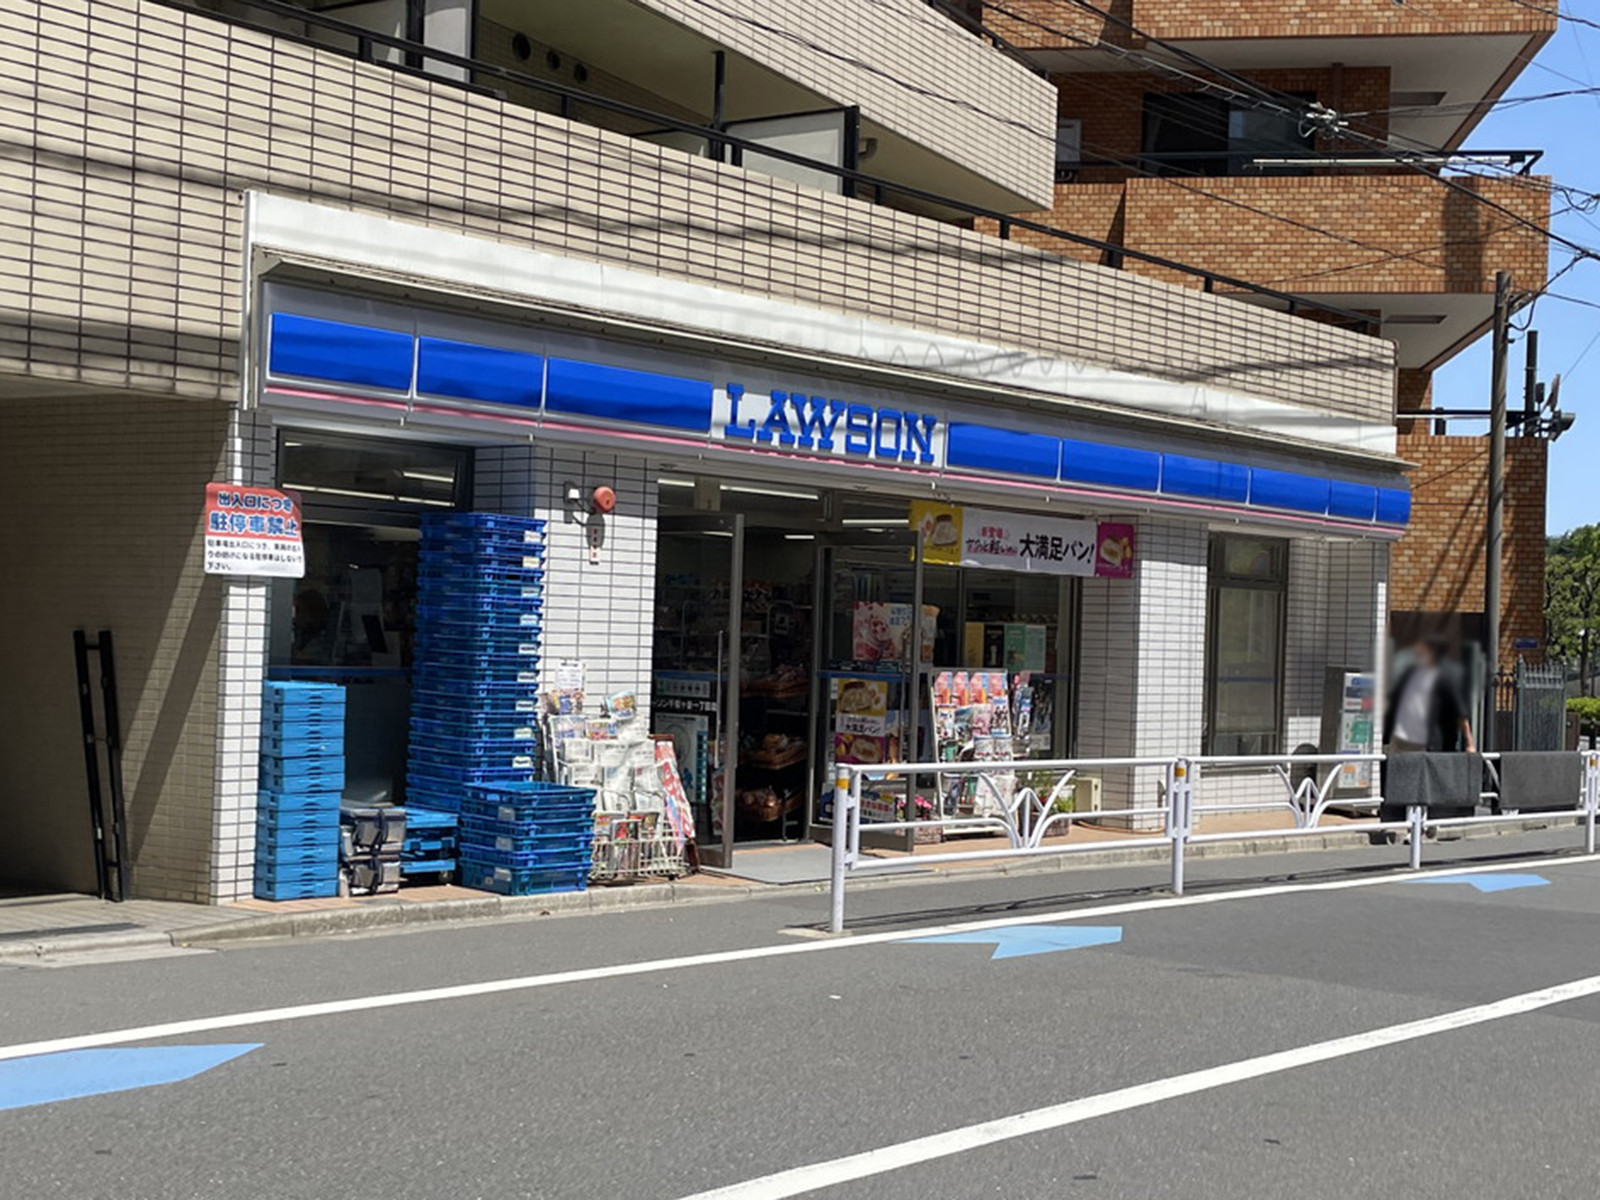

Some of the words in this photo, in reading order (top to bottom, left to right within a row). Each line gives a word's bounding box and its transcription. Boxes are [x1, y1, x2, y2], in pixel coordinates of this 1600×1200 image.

[724, 382, 938, 464] LAWSON
[218, 491, 292, 513] 出入口につき
[209, 511, 298, 537] 駐停車禁止
